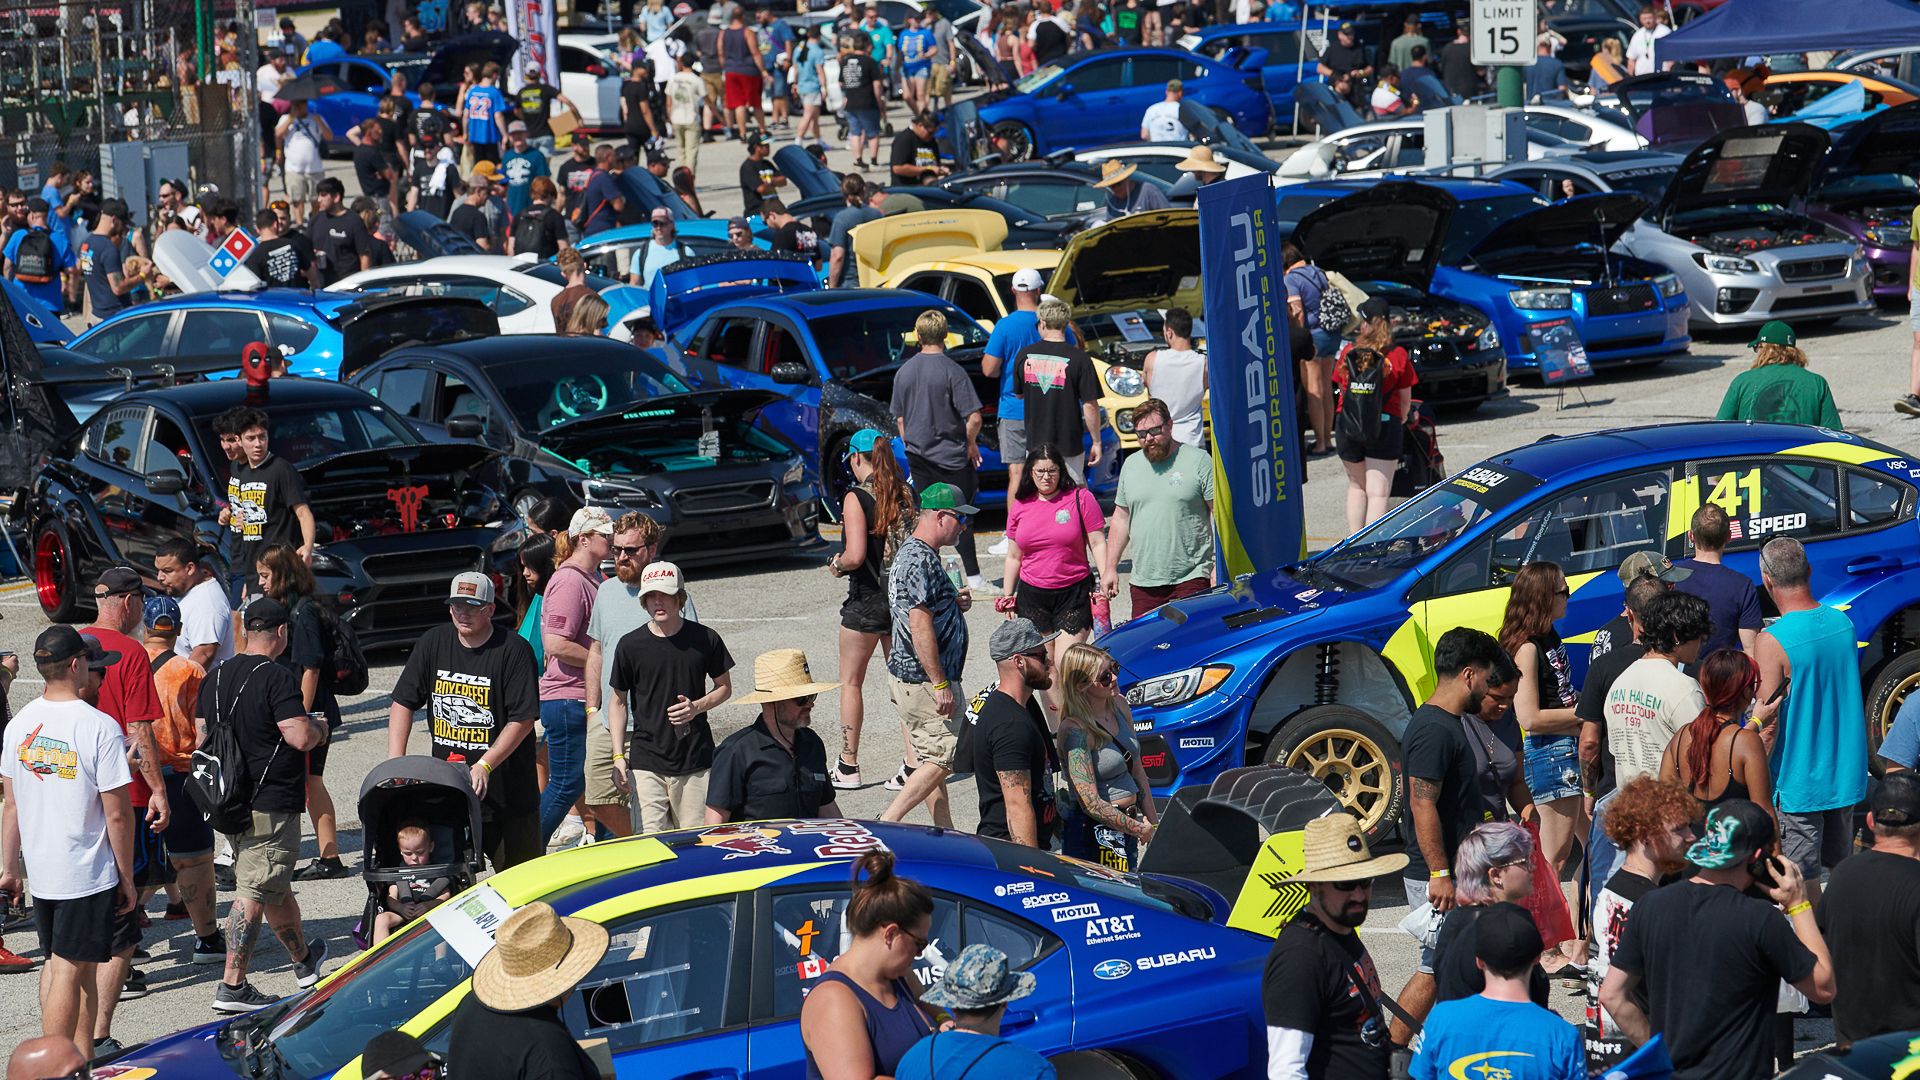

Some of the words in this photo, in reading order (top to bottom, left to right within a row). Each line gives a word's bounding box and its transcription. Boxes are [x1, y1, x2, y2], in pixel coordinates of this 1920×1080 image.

[1482, 8, 1522, 18] LIMIT
[1487, 27, 1519, 54] 15
[468, 96, 492, 120] 22
[1253, 209, 1267, 267] USA
[1231, 212, 1271, 507] SUBARU
[1261, 276, 1287, 502] MOTORSPORTS
[1886, 461, 1908, 470] VSC
[1706, 468, 1761, 517] 41
[1535, 511, 1553, 541] SportsCar
[1748, 512, 1806, 536] SPEED
[435, 679, 490, 709] BOXERFEST
[1610, 688, 1626, 703] VAN
[1629, 689, 1662, 711] HALEN
[434, 718, 490, 743] BOXERFEST
[1182, 737, 1213, 747] MOTUL
[1384, 773, 1402, 822] YOKOHAMA
[1022, 891, 1070, 908] sparco
[1056, 905, 1098, 920] MOTUL
[1086, 915, 1135, 938] AT&T
[1086, 934, 1114, 946] Ethernet
[1114, 931, 1142, 942] Services
[1136, 947, 1217, 971] SUBARU
